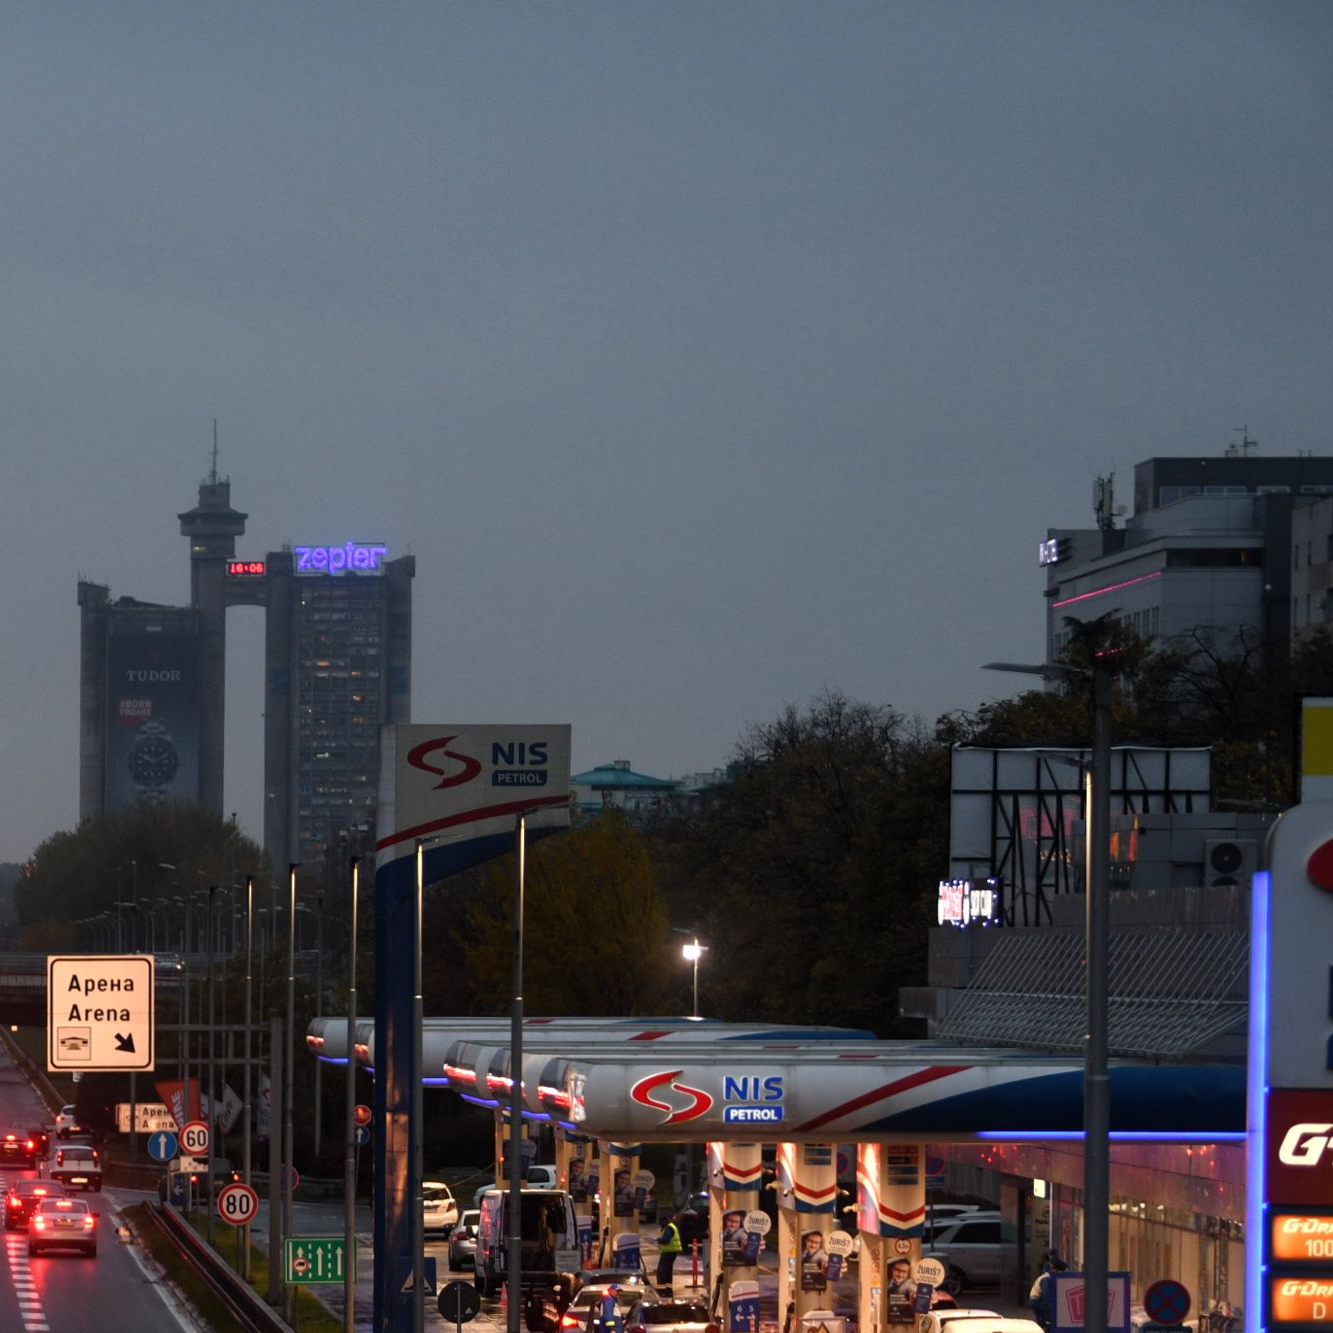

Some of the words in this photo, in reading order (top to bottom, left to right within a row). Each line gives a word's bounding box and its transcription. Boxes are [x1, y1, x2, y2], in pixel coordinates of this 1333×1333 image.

[295, 542, 386, 575] zepter
[230, 563, 263, 573] 16:06
[126, 670, 181, 682] TUDOR
[492, 743, 548, 765] NIS
[497, 771, 544, 784] PETROL
[67, 974, 135, 997] Арена
[67, 1003, 131, 1021] Arena
[723, 1076, 785, 1101] NIS
[729, 1108, 780, 1121] PETROL
[186, 1131, 207, 1147] 60
[226, 1194, 250, 1214] 80
[1305, 1239, 1333, 1257] 100
[1313, 1302, 1326, 1319] D
